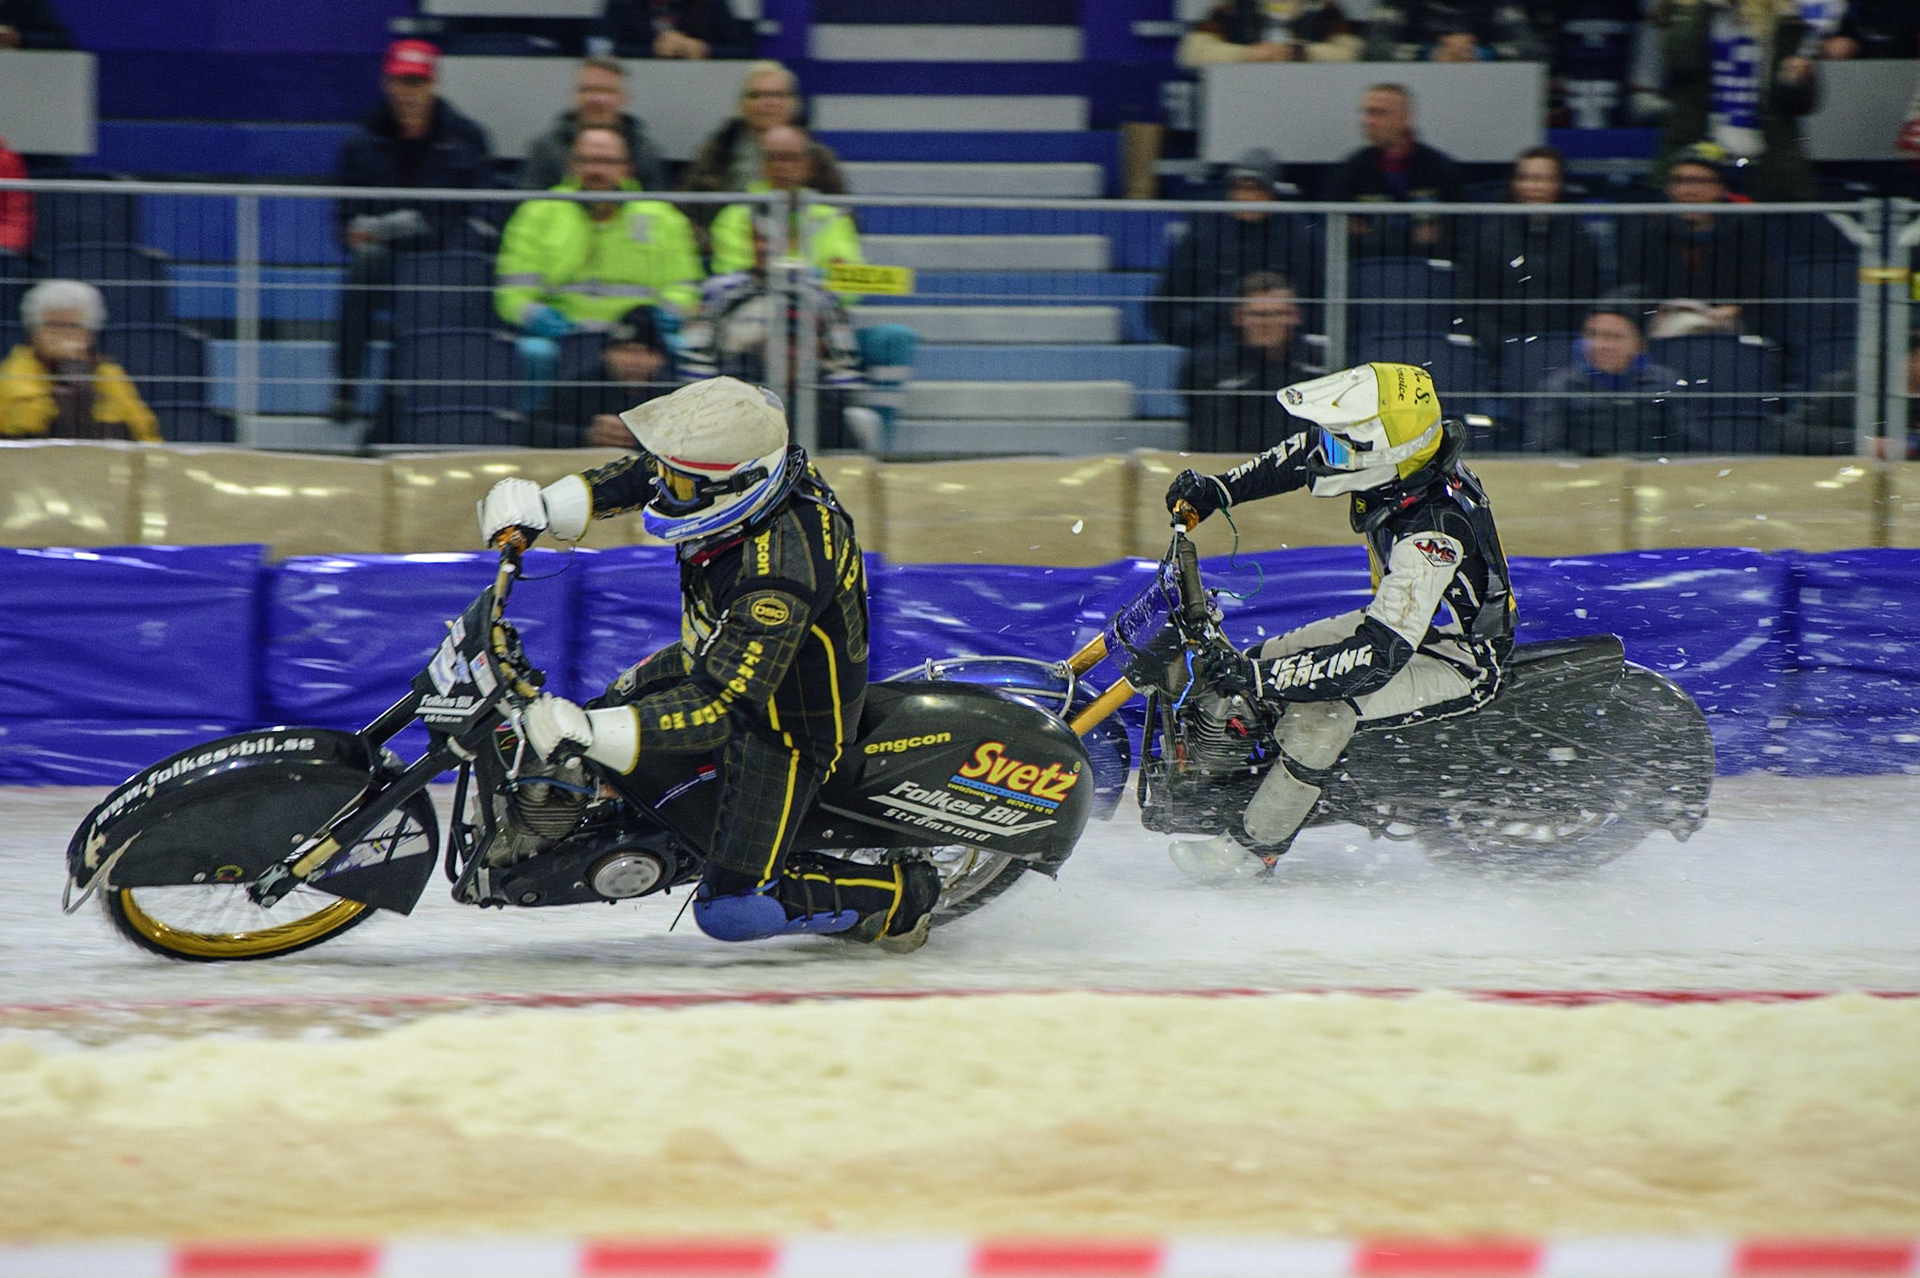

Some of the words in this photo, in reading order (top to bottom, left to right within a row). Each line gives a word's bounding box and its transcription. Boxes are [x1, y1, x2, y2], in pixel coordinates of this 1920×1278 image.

[1274, 644, 1373, 691] RACING
[864, 731, 952, 755] engcon
[958, 741, 1078, 802] Svetz
[889, 780, 986, 816] Folkes
[981, 805, 1028, 826] Bil
